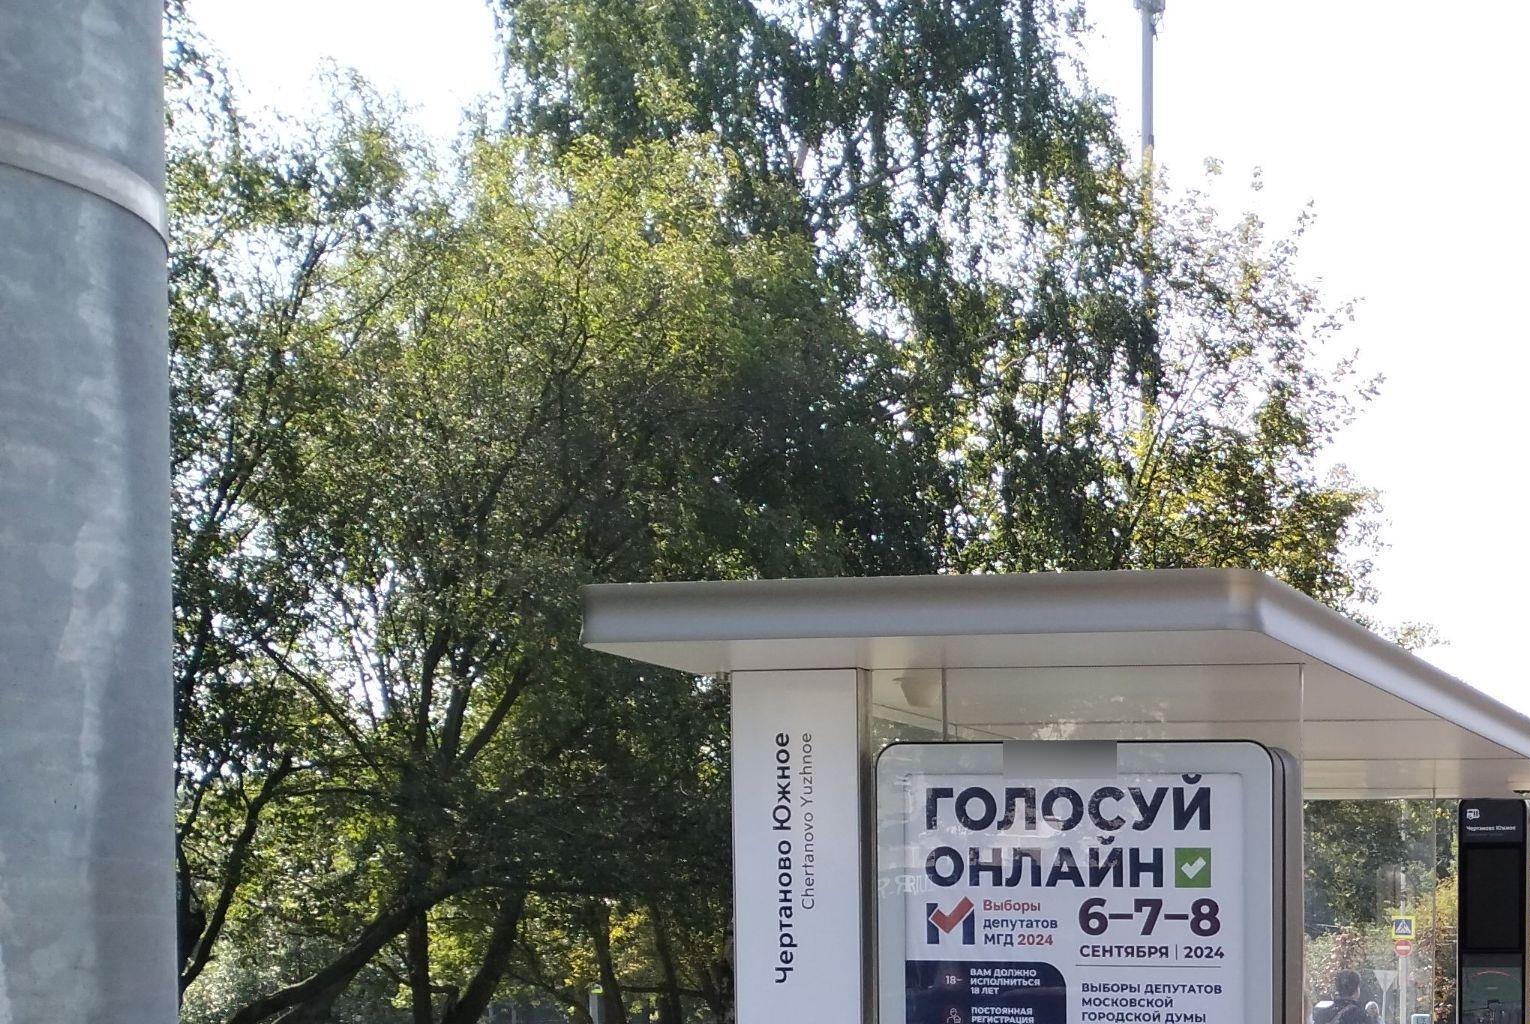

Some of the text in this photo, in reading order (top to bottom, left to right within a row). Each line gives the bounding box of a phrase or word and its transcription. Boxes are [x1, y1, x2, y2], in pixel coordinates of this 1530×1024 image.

[926, 774, 1211, 831] ГОЛОСУЙ
[799, 733, 815, 910] Chertanovo Yuzhnoe
[772, 732, 797, 984] Чертаново Южное
[925, 836, 1163, 888] ОНЛАЙН
[983, 900, 1041, 913] Выборы
[983, 917, 1058, 930] депутатов
[984, 934, 1054, 947] МГД 2024
[1079, 945, 1225, 959] СЕНТЯБРЯ 2024
[970, 968, 1037, 978] ВАМ ДОЛЖНО
[970, 978, 1041, 986] ИСПОЛНИТЬСЯ
[971, 987, 999, 995] 18 ЛЕТ
[1082, 983, 1222, 995] ВЫБОРЫ ДЕПУТАТОВ
[1082, 997, 1173, 1008] МОСКОВСКОЙ
[971, 1007, 1033, 1015] ПОСТОЯННАЯ
[1082, 1011, 1206, 1024] ГОРОДСКОЙ ДУМЫ
[971, 1016, 1035, 1024] РЕГИСТРАЦИЯ
